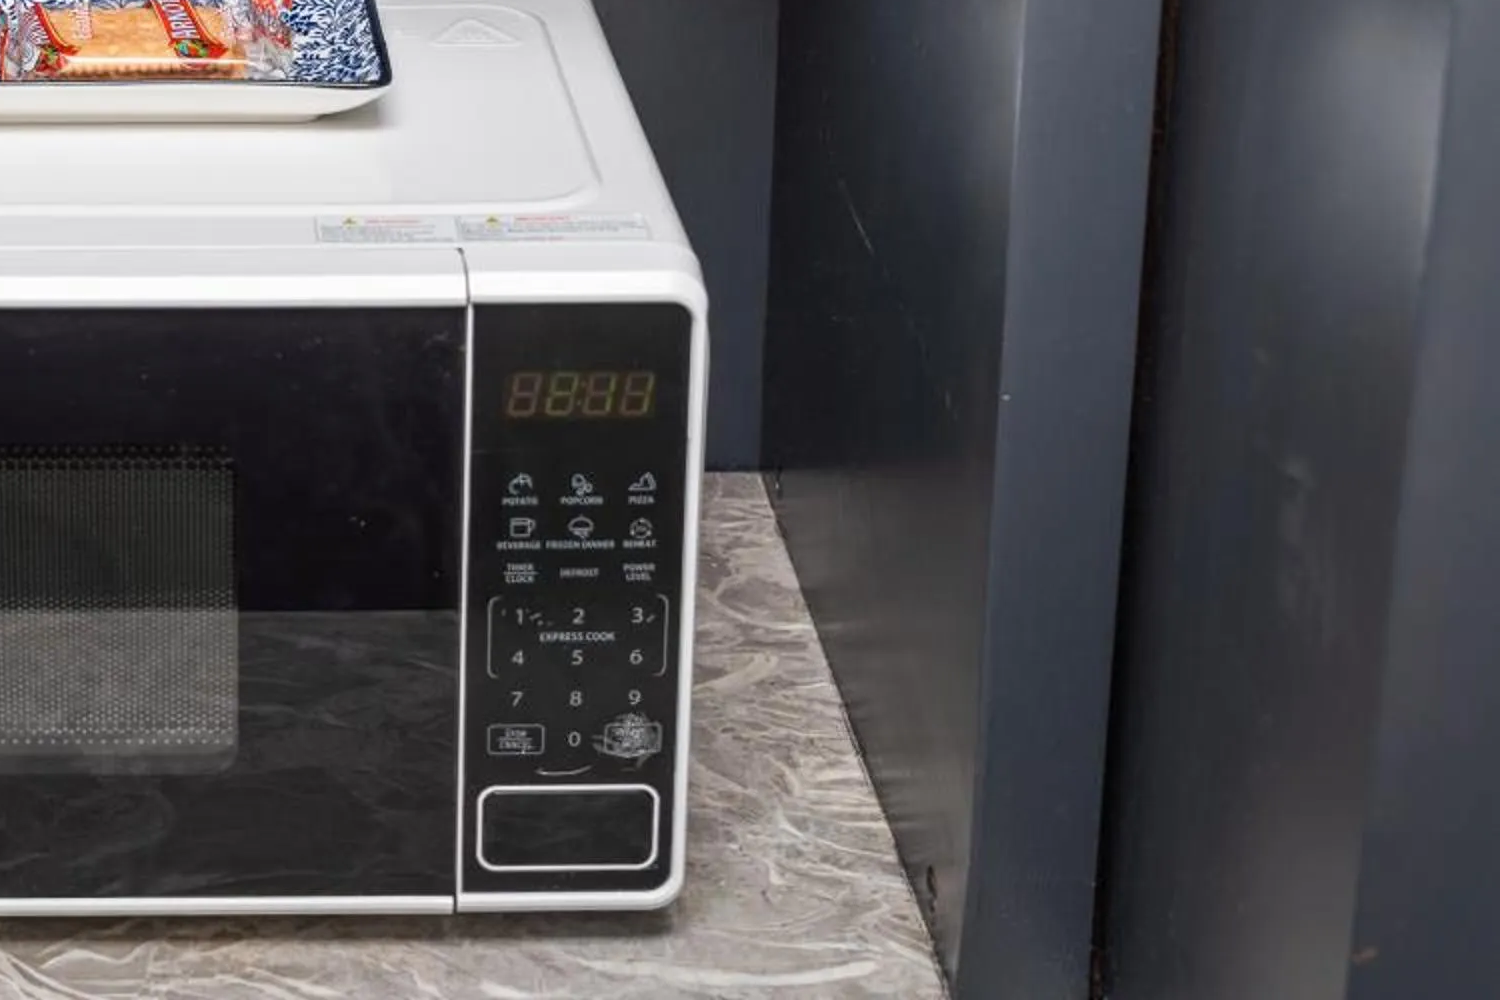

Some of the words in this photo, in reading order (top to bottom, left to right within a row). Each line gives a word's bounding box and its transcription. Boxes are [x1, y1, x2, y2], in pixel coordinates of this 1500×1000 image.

[560, 494, 603, 506] POPCORN
[496, 538, 541, 550] BEVERAGE
[546, 539, 580, 549] FROZEN
[560, 567, 599, 578] DEFROST
[623, 562, 655, 572] POWER
[625, 572, 651, 582] LEVEL
[515, 608, 524, 625] 1
[573, 608, 585, 625] 2
[631, 607, 643, 623] 3
[539, 632, 584, 642] EXPRESS
[586, 632, 615, 642] COOK
[512, 650, 524, 665] 4
[572, 650, 583, 665] 5
[630, 649, 643, 665] 6
[511, 691, 523, 706] 7
[570, 690, 582, 706] 8
[629, 689, 641, 705] 9
[568, 731, 581, 747] 0
